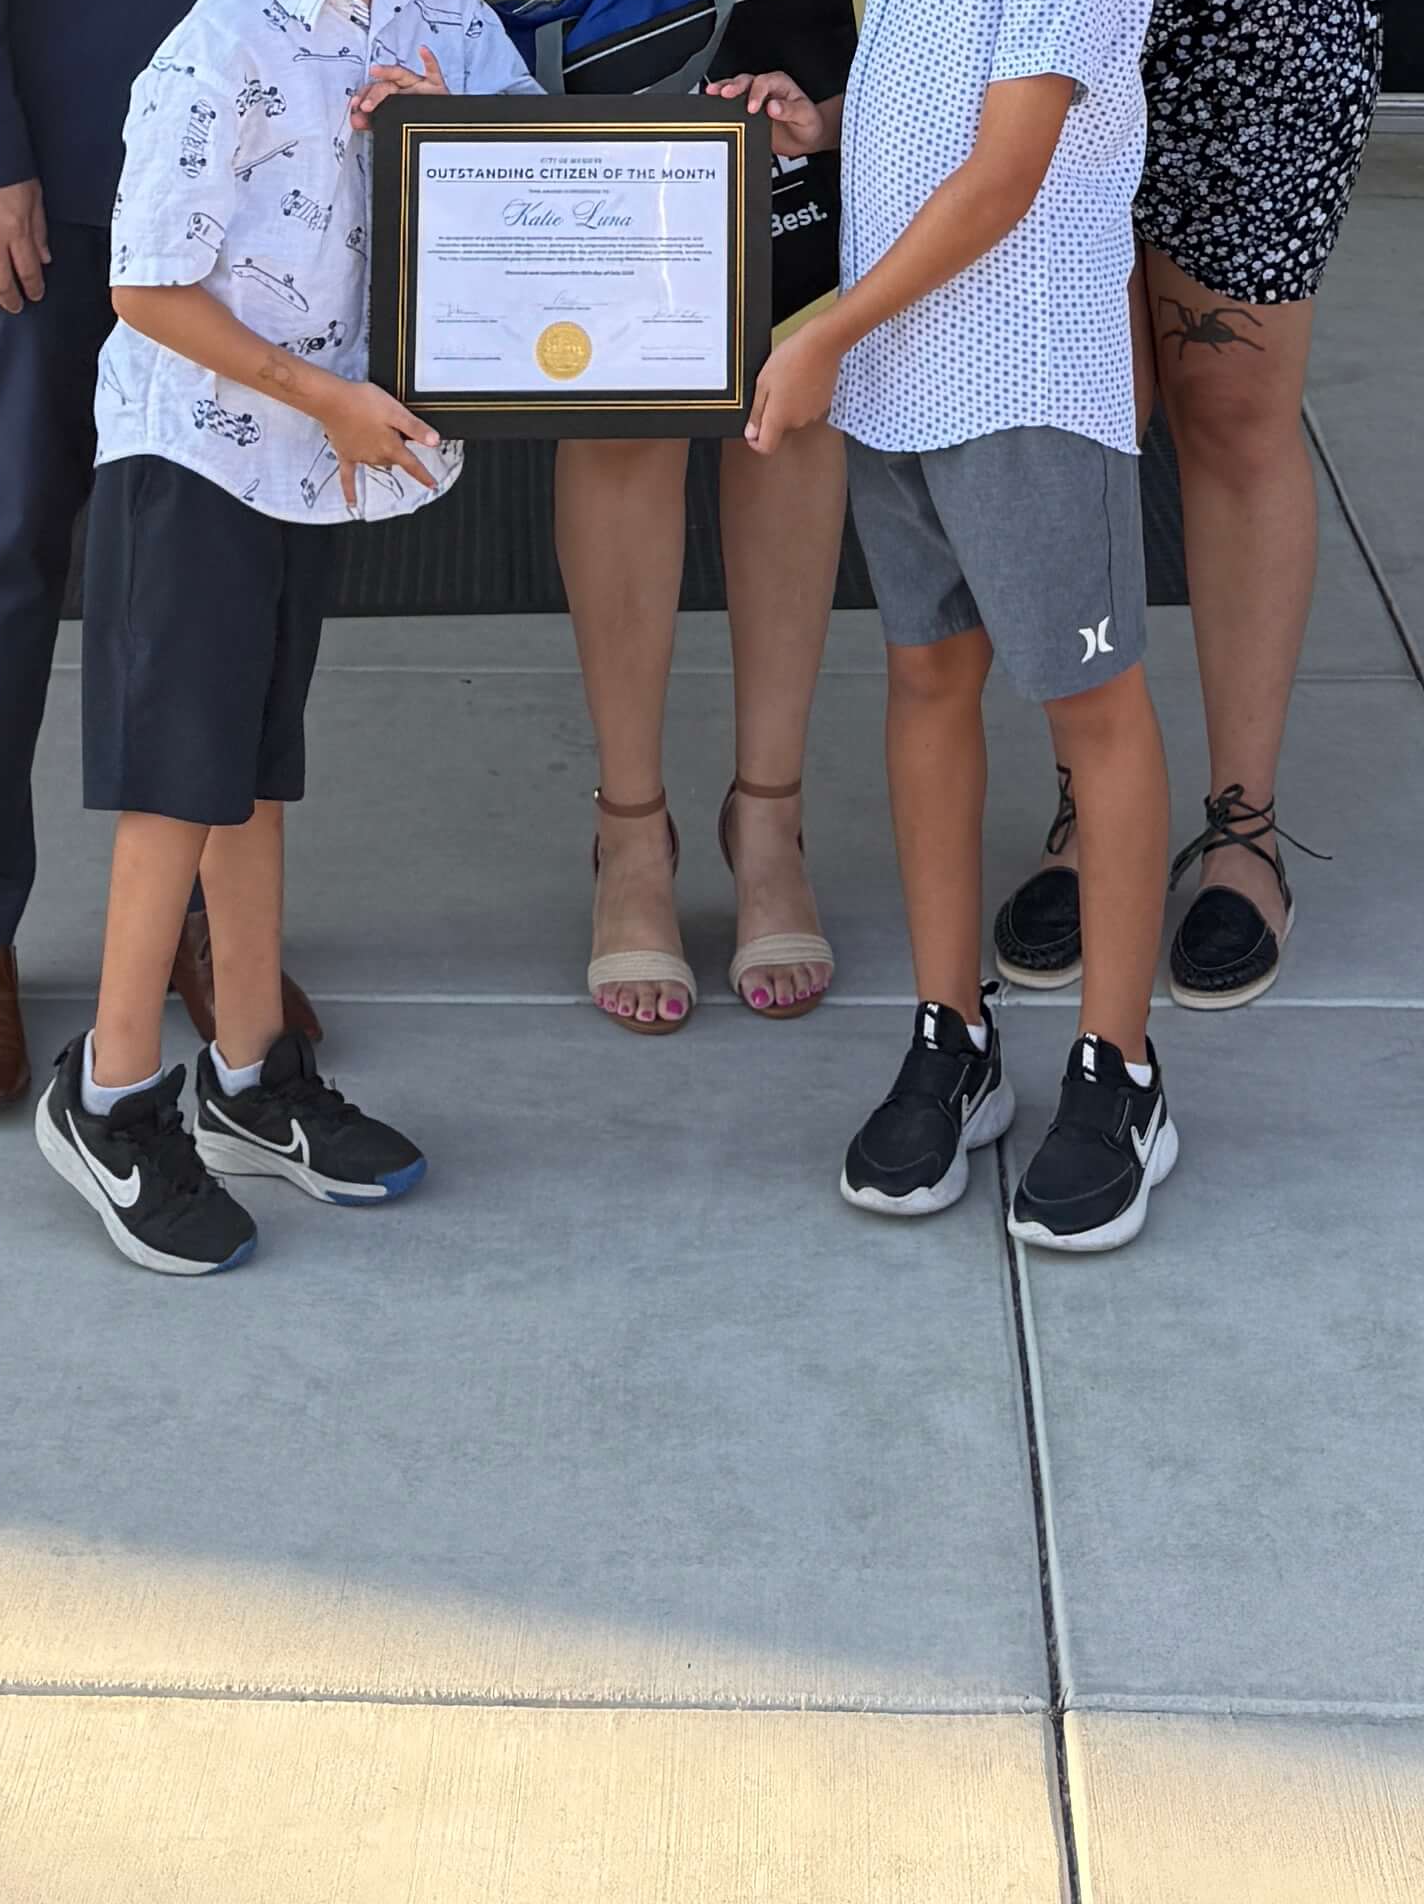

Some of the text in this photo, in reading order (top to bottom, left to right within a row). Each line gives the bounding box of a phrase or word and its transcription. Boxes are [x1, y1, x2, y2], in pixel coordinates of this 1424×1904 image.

[426, 167, 716, 180] OUTSTANDING CITIZEN OF THE MONTH
[502, 197, 633, 230] Katie Luna
